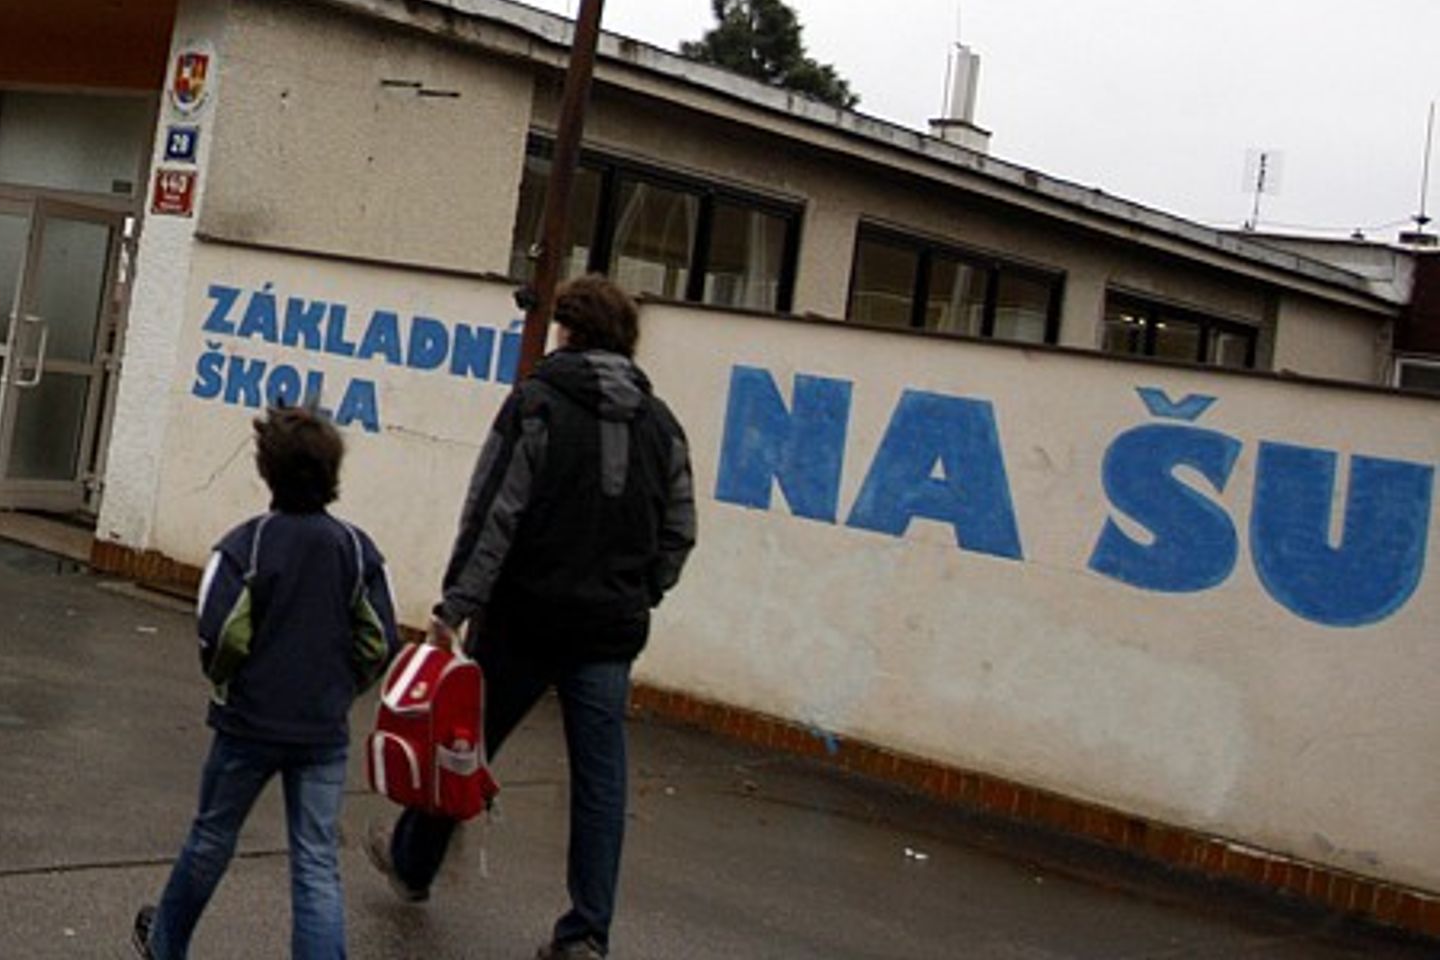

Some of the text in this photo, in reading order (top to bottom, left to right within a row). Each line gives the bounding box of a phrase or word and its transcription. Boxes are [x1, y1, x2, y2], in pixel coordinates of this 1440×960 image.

[202, 281, 525, 385] ZÁKLADNÍ
[192, 340, 380, 433] ŠKOLA
[713, 364, 1435, 629] NA ŠU
